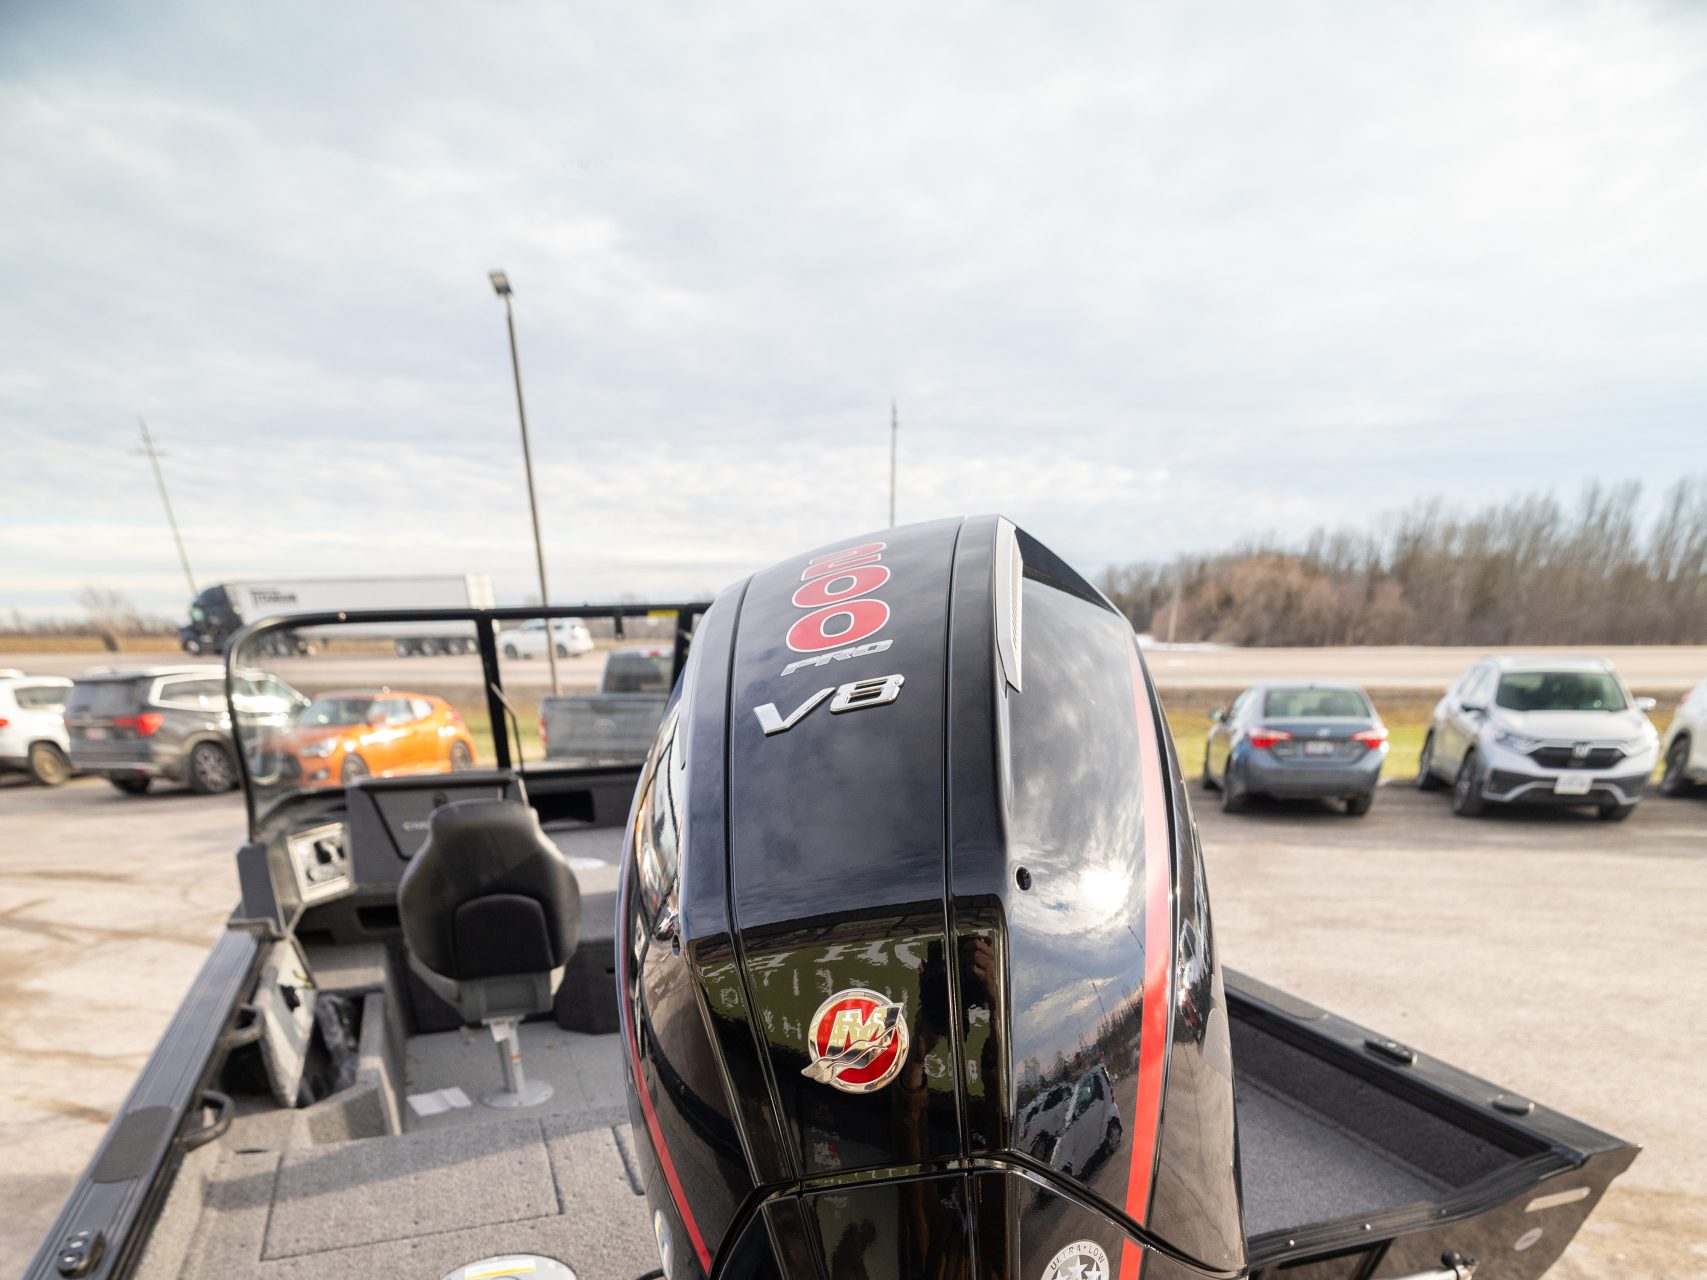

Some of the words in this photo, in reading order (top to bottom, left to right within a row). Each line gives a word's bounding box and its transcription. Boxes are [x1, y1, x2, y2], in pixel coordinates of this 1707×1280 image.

[780, 639, 893, 677] PRO
[752, 674, 905, 737] V8
[1050, 1244, 1081, 1271] ULTRA
[1089, 1246, 1105, 1264] LOW
